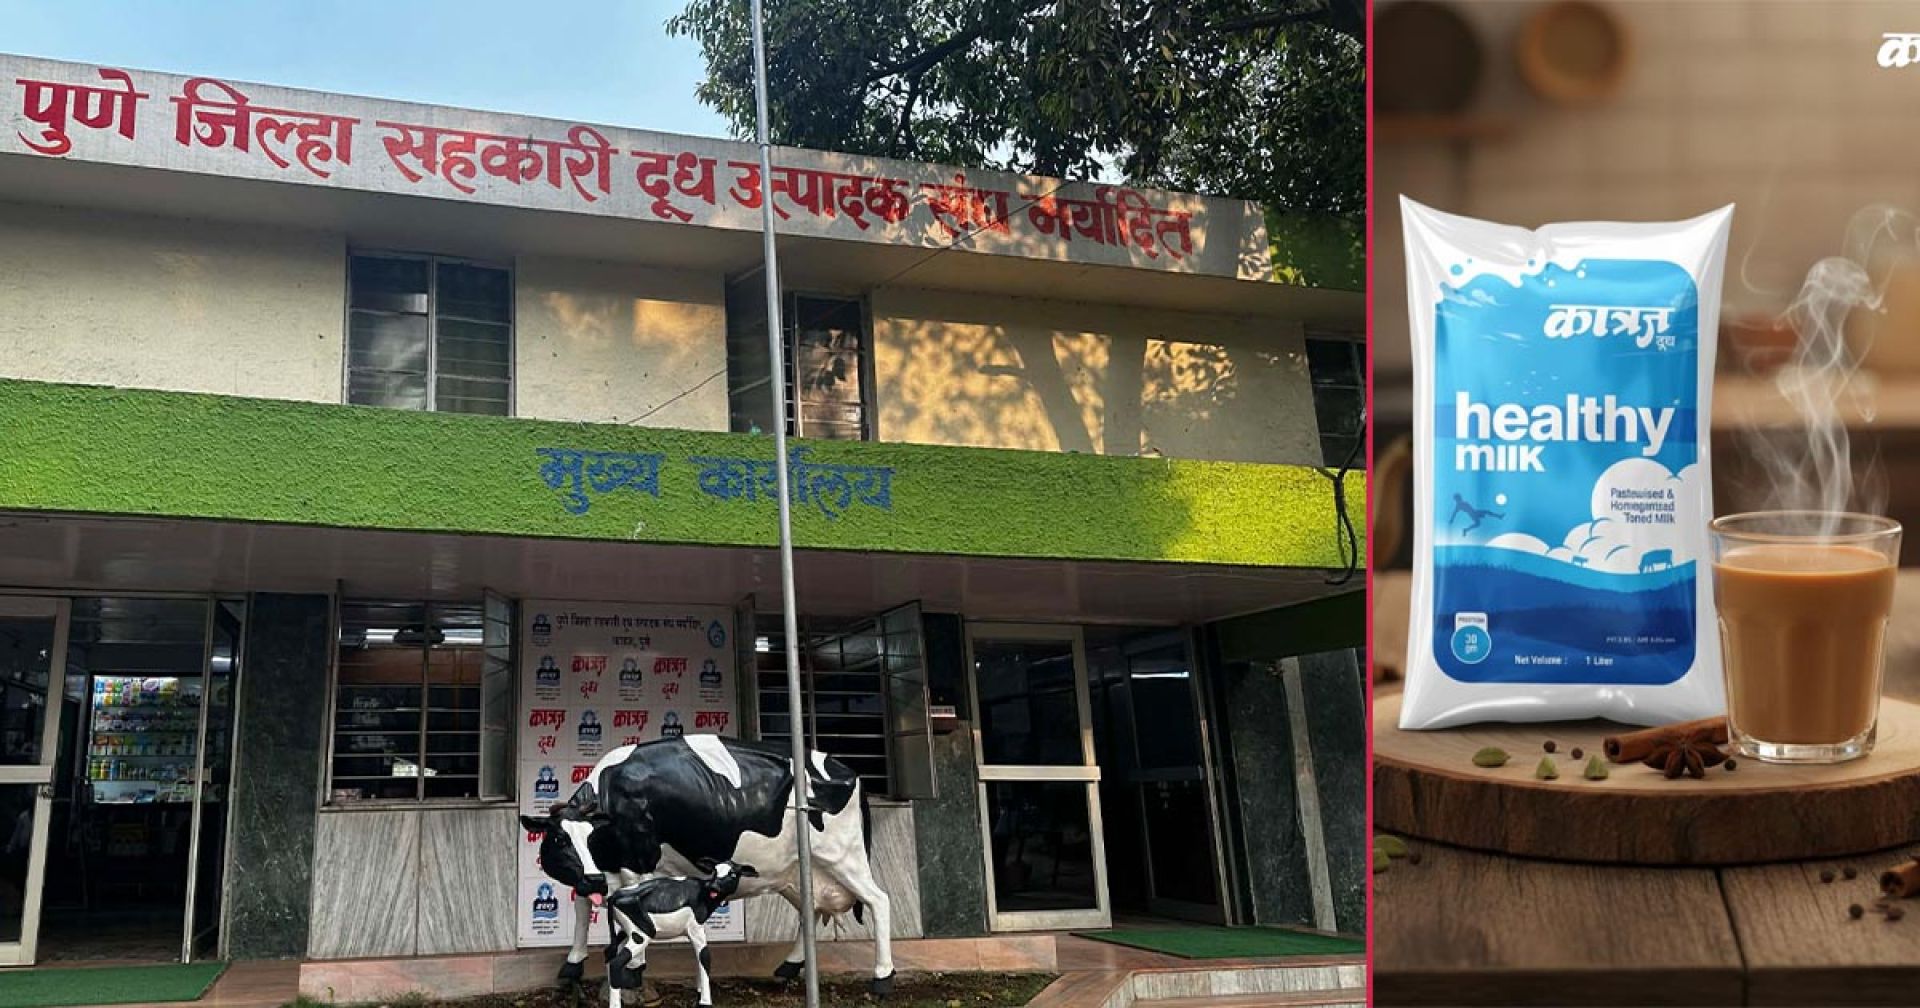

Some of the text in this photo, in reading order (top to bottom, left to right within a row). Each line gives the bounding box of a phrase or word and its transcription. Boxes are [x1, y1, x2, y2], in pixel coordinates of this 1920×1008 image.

[16, 69, 1193, 259] पुणे जिल्हा सहकारी दूध उत्पादक संघ मर्यादित
[1543, 304, 1676, 348] कात्रज
[1455, 391, 1675, 456] healthy
[536, 446, 896, 521] मुख्य कार्यालय
[1455, 444, 1546, 472] milk
[1667, 488, 1675, 499] &
